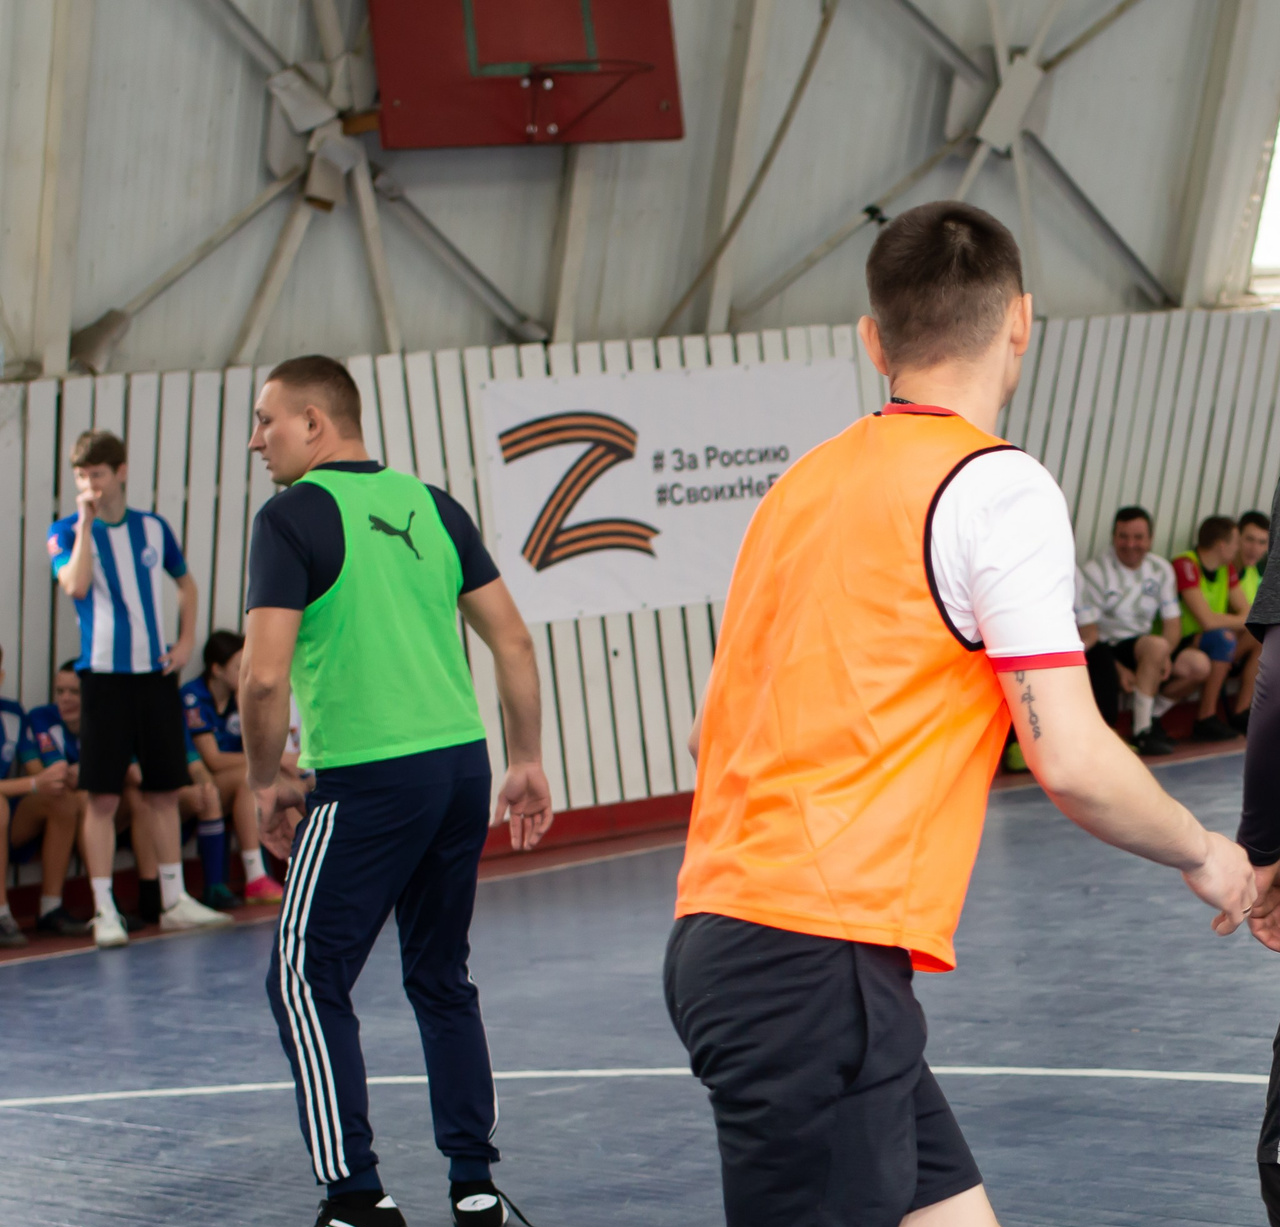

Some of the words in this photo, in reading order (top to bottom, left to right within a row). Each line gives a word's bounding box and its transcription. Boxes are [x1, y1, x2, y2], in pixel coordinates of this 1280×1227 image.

[498, 411, 661, 573] Z
[672, 448, 699, 472] За
[705, 445, 790, 469] Россию
